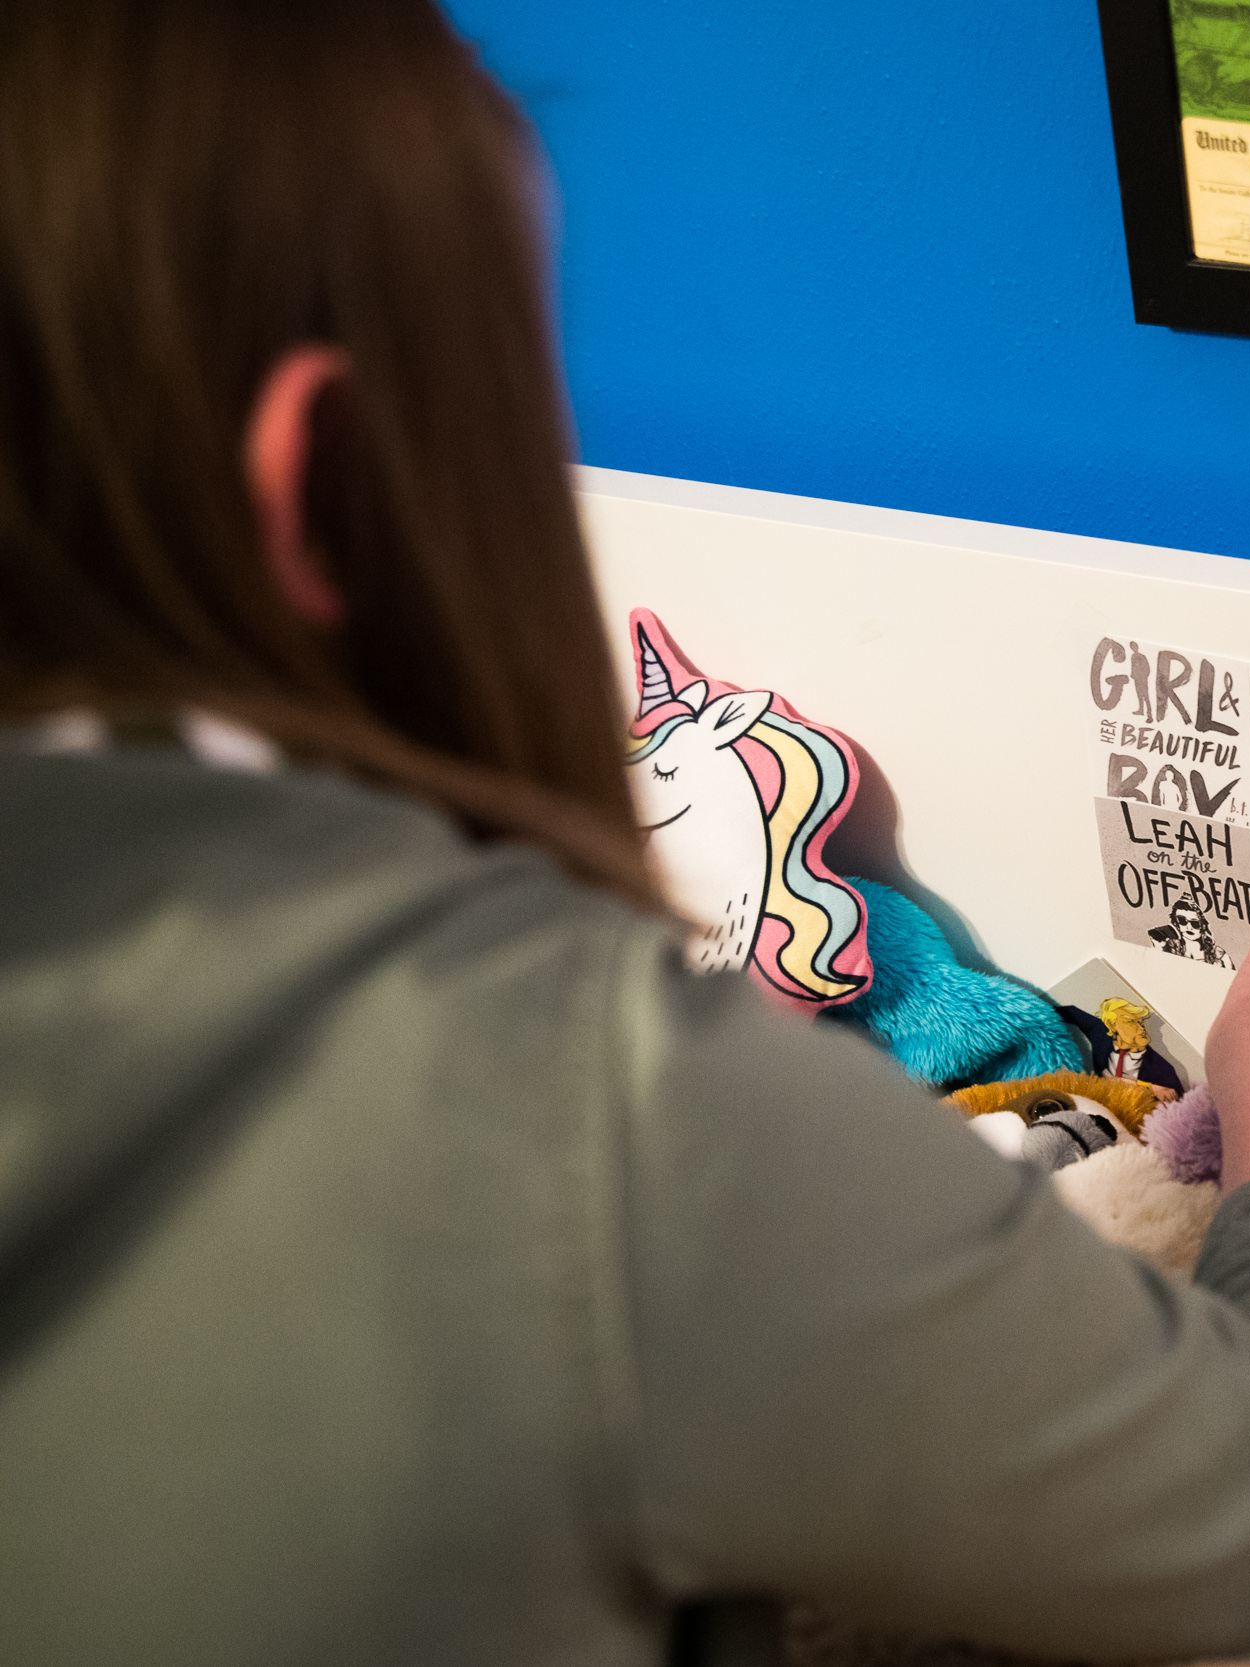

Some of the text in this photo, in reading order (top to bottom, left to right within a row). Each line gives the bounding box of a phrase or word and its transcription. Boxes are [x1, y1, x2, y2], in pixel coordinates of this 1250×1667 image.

[1194, 130, 1248, 155] United
[1100, 718, 1117, 744] HER
[1120, 723, 1240, 770] BEAUTIFUL
[1120, 801, 1233, 867] LEAH
[1147, 850, 1217, 873] on the
